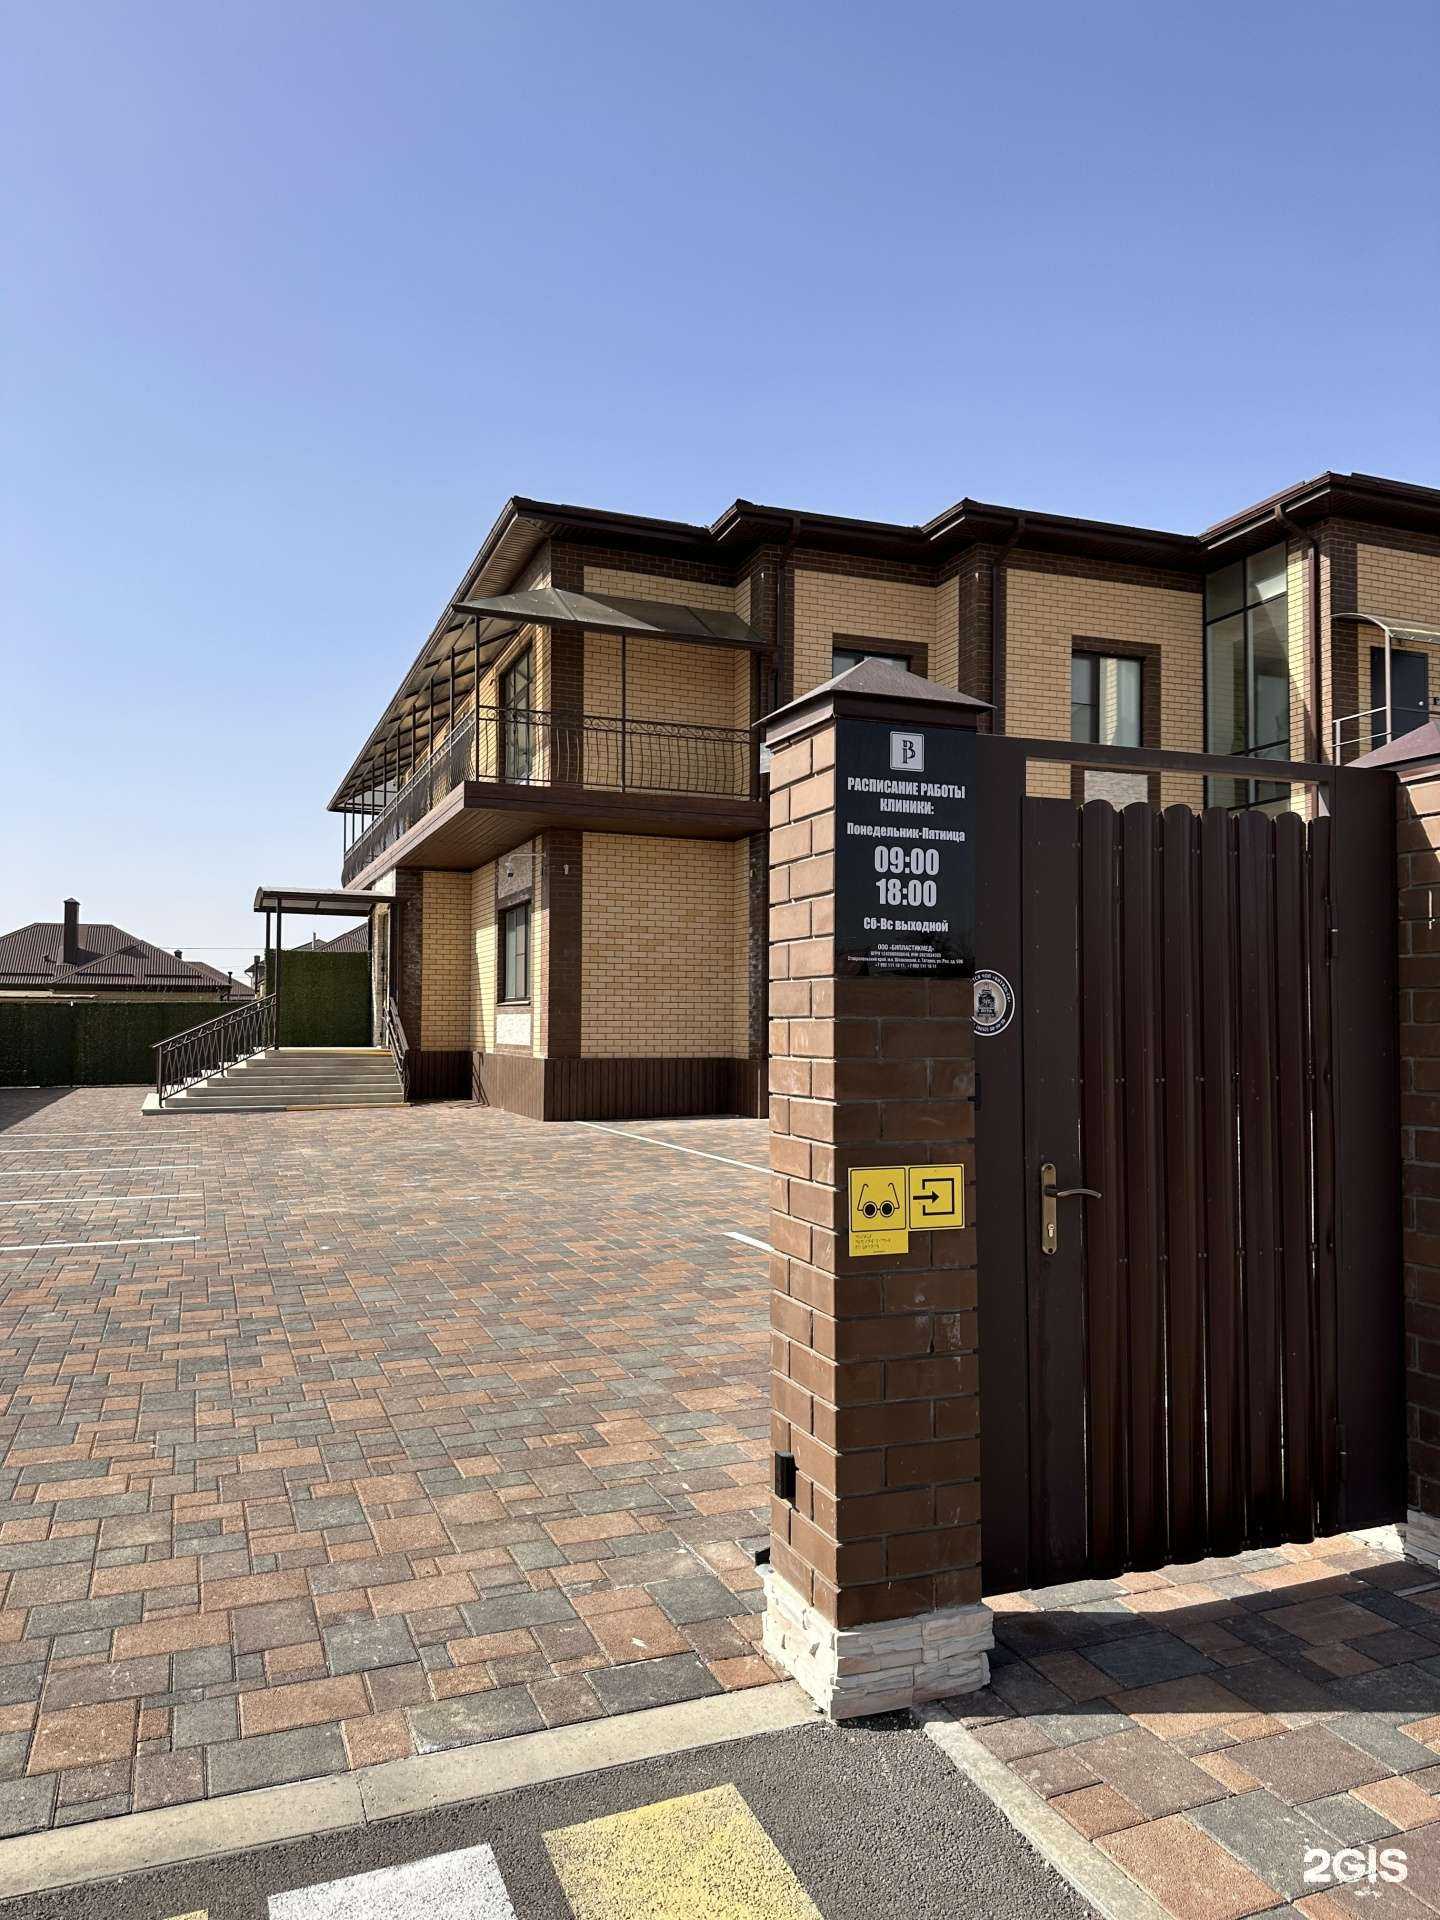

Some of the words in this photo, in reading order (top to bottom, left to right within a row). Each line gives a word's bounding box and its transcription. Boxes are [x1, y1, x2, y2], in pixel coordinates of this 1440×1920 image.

[847, 777, 919, 796] РАСПИСАНИЕ
[920, 782, 966, 799] РАБОТЫ
[880, 798, 935, 815] КЛИНИКИ:
[846, 822, 966, 842] Понедельник-Пятница
[874, 845, 940, 876] 09:00
[875, 878, 937, 907] 18:00
[863, 917, 894, 930] Сб-Вс
[895, 919, 949, 933] выходной
